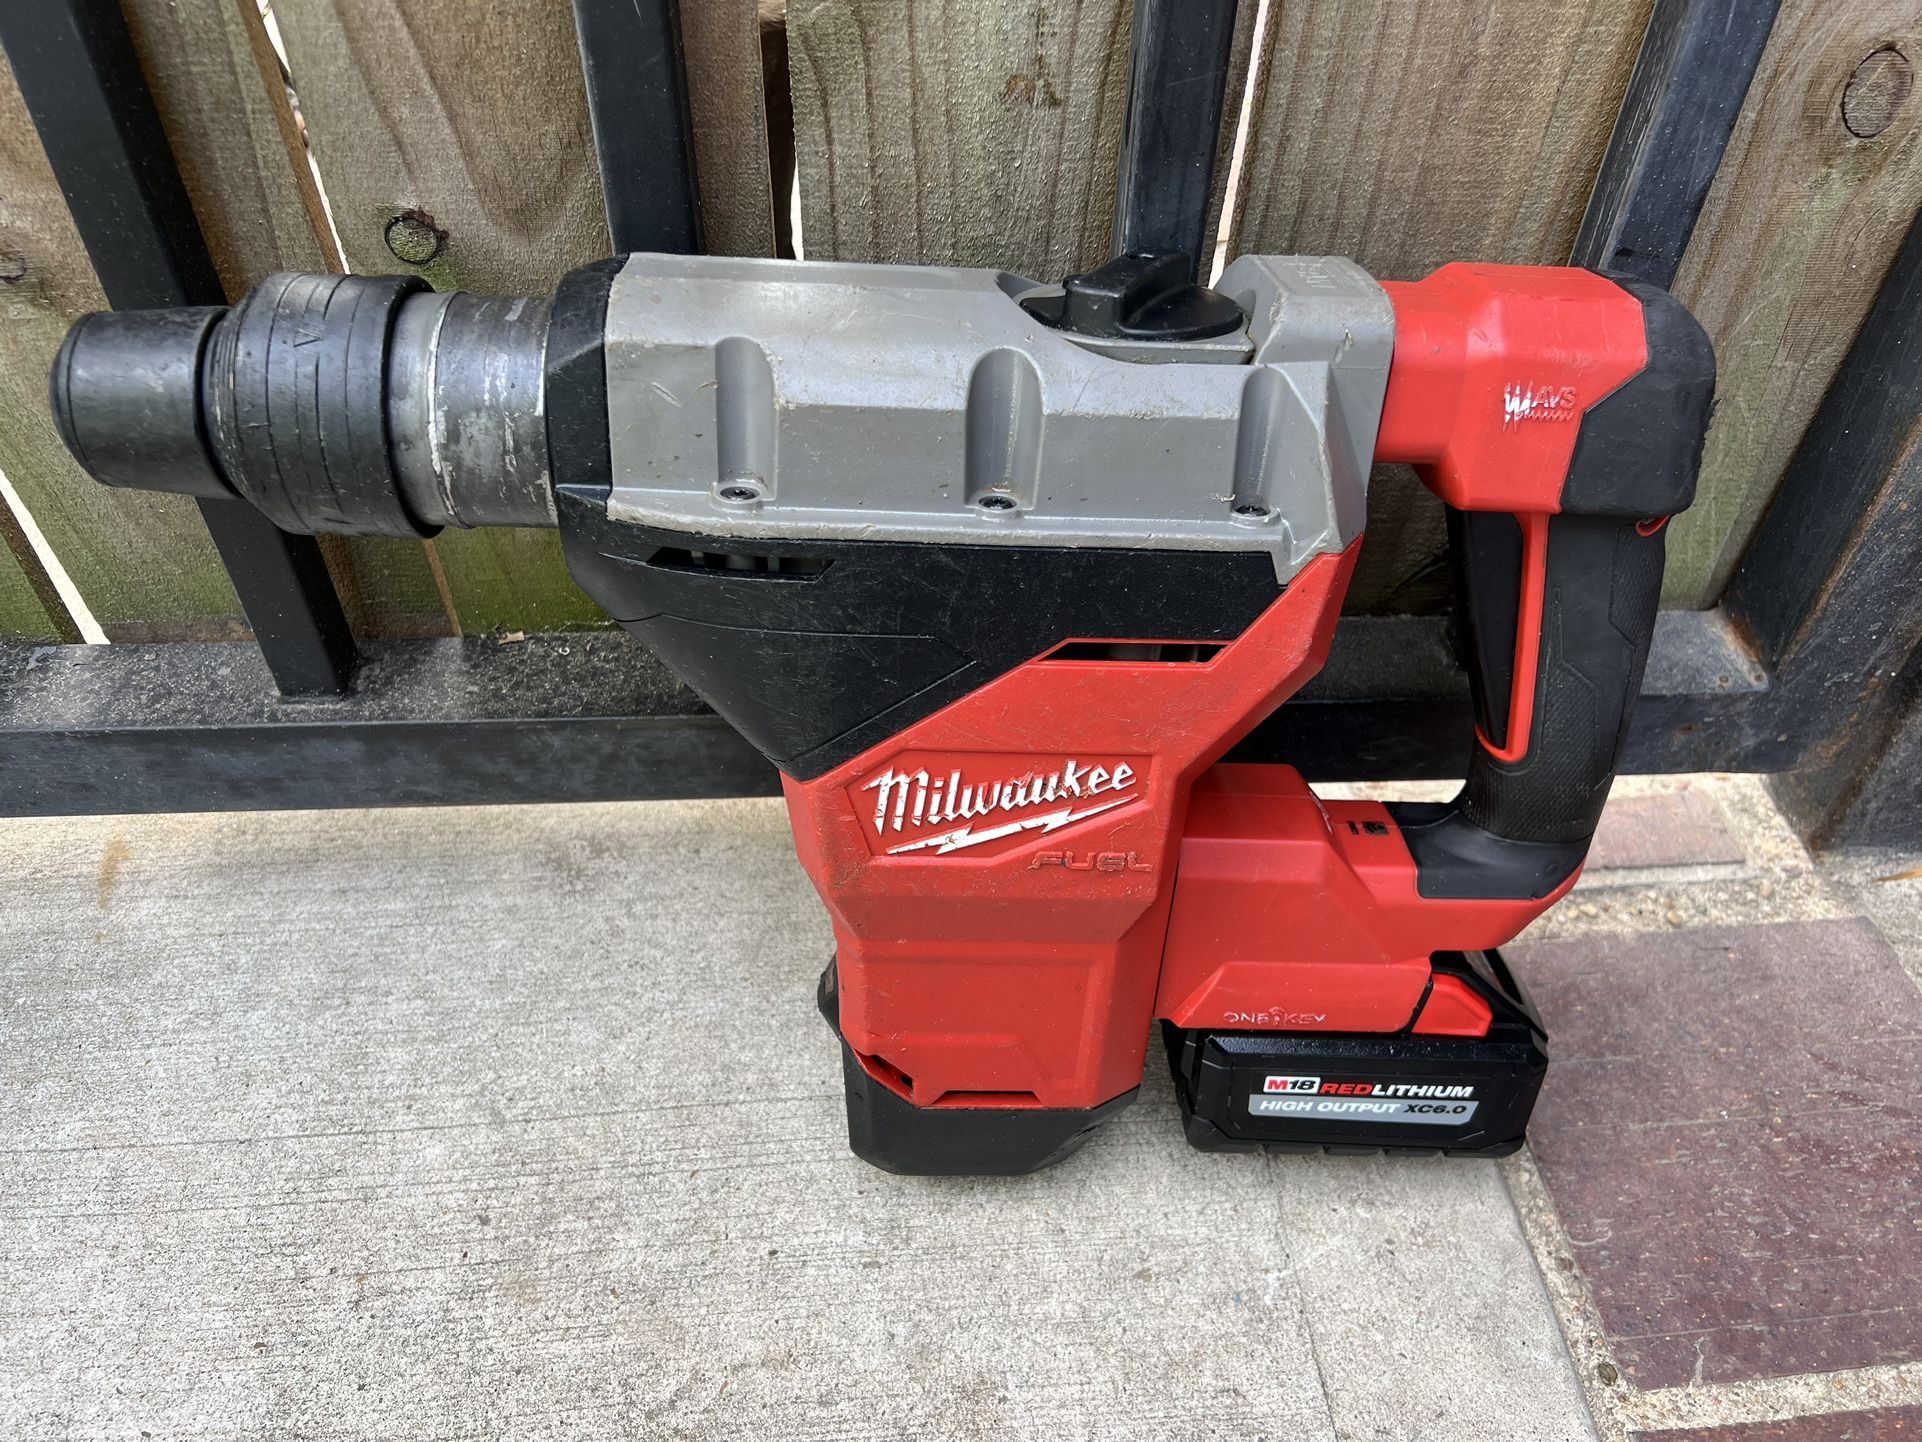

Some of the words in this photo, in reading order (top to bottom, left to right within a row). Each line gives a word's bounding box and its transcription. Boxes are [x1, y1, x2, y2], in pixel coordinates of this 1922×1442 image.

[861, 759, 1136, 836] Milwaukee
[1030, 850, 1154, 873] FUEL
[1266, 1079, 1317, 1092] M18
[1319, 1082, 1475, 1098] REDLITHIUM
[1259, 1099, 1315, 1112] HIGH
[1316, 1101, 1402, 1114] OUTPUT
[1402, 1103, 1468, 1115] XC6.0
